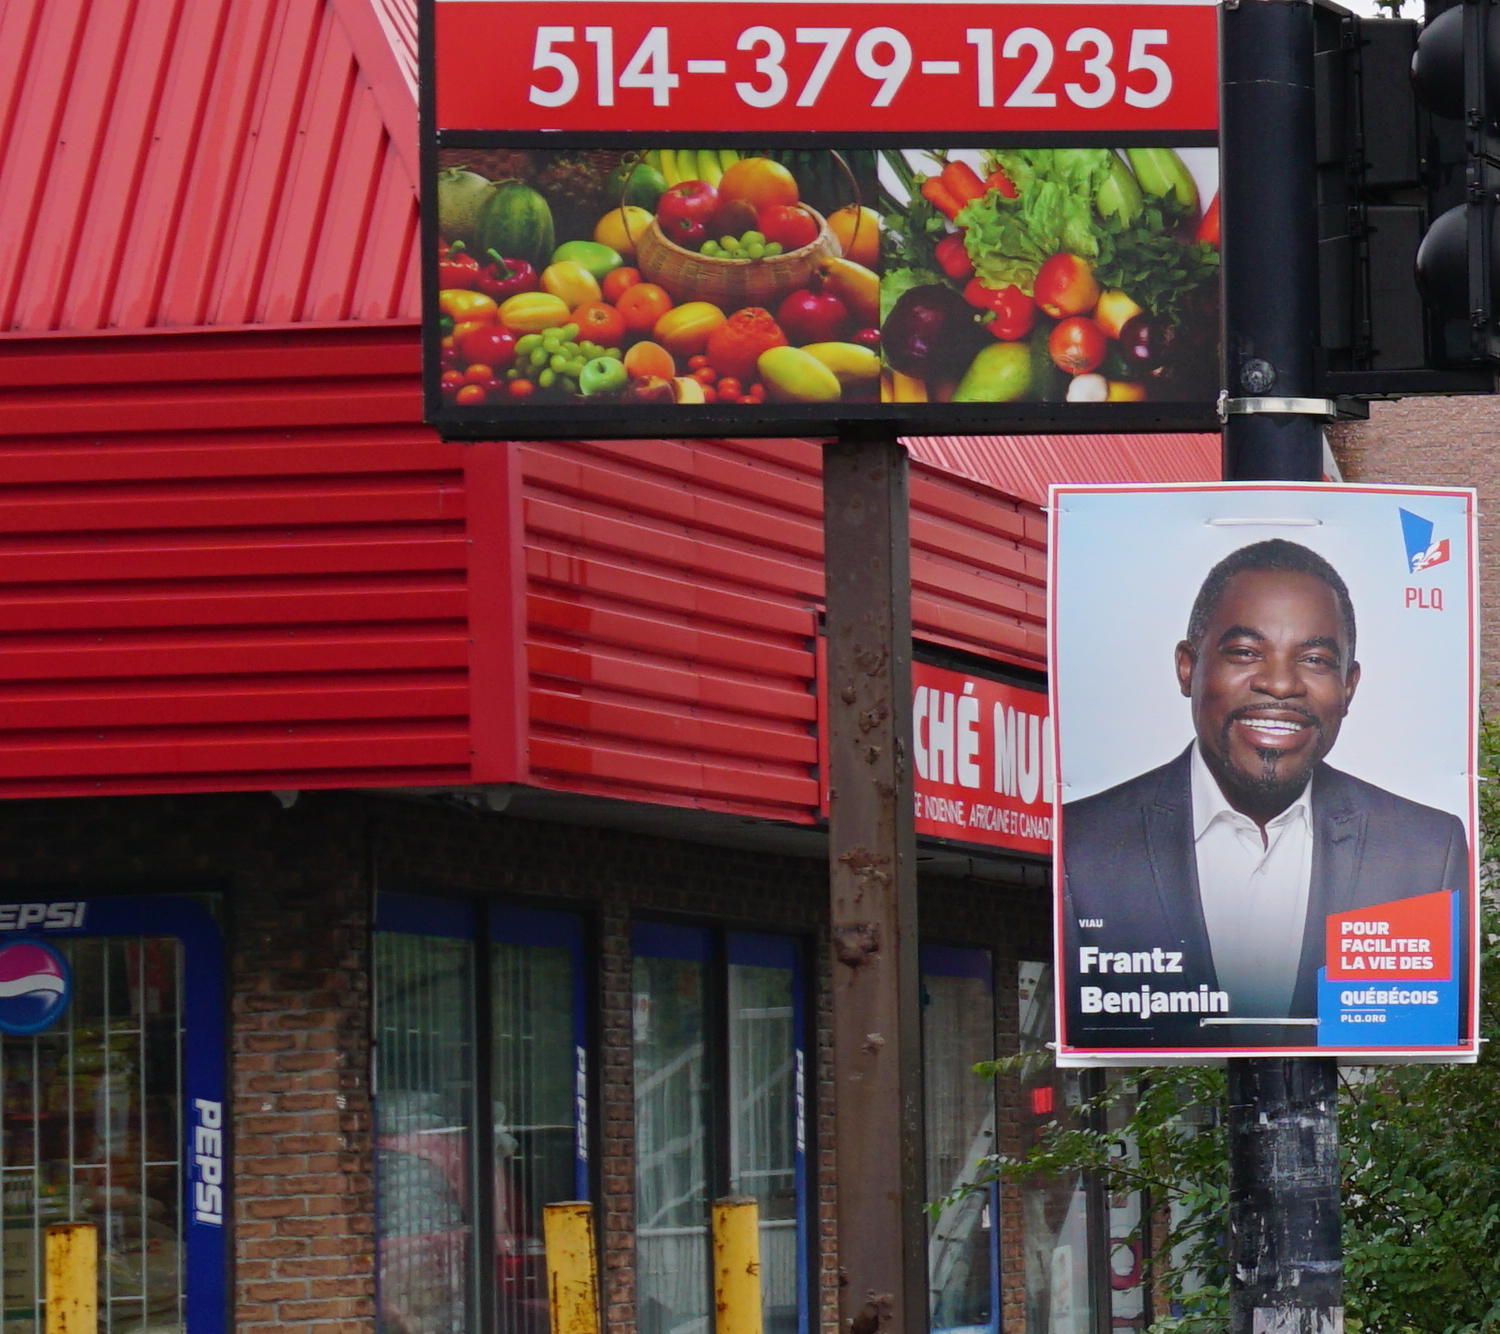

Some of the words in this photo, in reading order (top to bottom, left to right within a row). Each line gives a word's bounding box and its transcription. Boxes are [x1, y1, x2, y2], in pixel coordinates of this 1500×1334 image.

[528, 25, 1174, 109] 514-379-1235
[1405, 587, 1443, 611] PLQ
[913, 681, 981, 789] CHÉ
[0, 902, 87, 930] EPSI
[1078, 918, 1104, 928] VIAU
[1341, 921, 1390, 935] POUR
[1341, 939, 1431, 953] FACILITER
[1079, 946, 1183, 974] Frantz
[1341, 956, 1366, 970] LA
[1368, 956, 1397, 969] VIE
[1400, 956, 1434, 969] DES
[1080, 984, 1229, 1019] Benjamin
[1340, 987, 1439, 1006] QUÉBÉCOIS
[1340, 1014, 1387, 1023] PLQ.ORG
[195, 1097, 223, 1226] PEPSI
